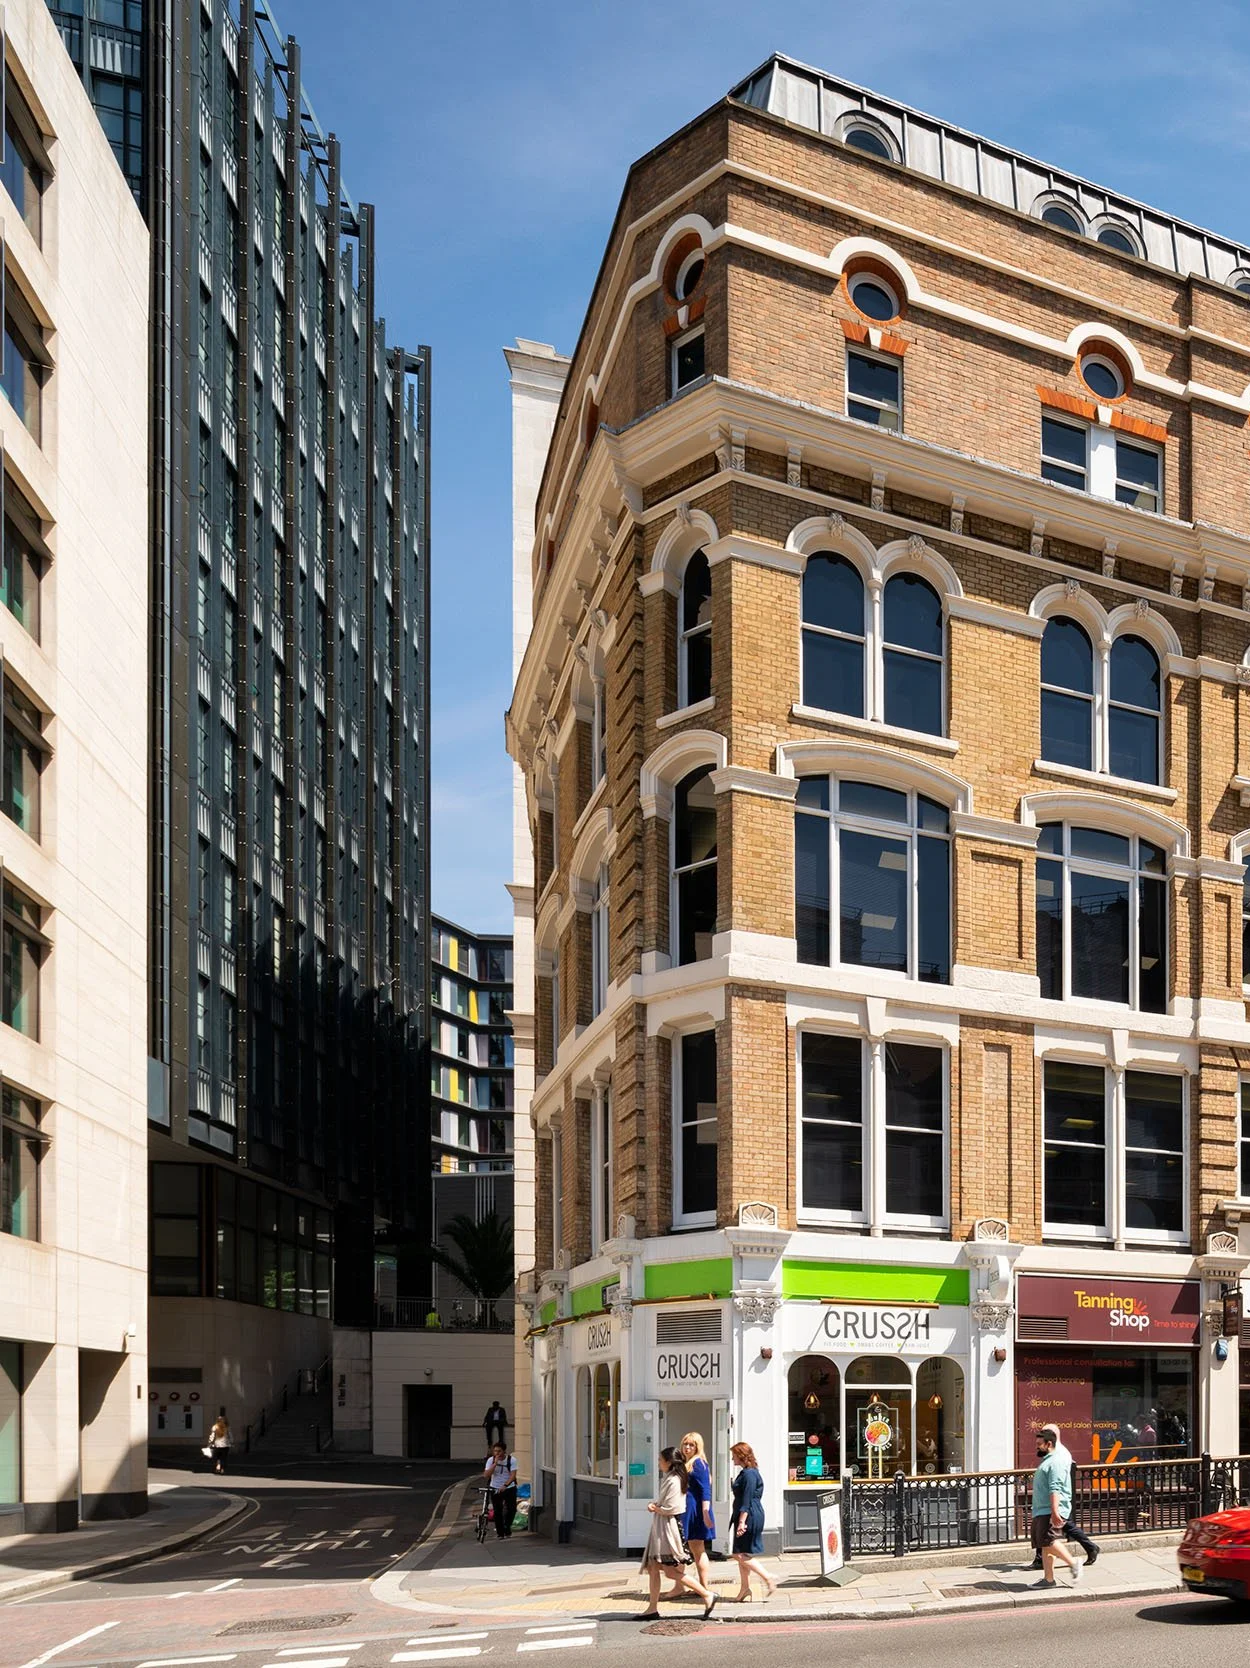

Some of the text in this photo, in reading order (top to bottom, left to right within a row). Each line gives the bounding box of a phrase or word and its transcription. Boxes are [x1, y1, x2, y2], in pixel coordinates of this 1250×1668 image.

[1073, 1290, 1135, 1315] Tanning
[1109, 1309, 1196, 1332] Shop Time to shine
[1024, 1357, 1072, 1367] Professional
[1059, 1376, 1086, 1386] tanning
[1031, 1399, 1066, 1408] Spray tan
[1073, 1421, 1092, 1429] salon
[1093, 1421, 1118, 1430] waxing
